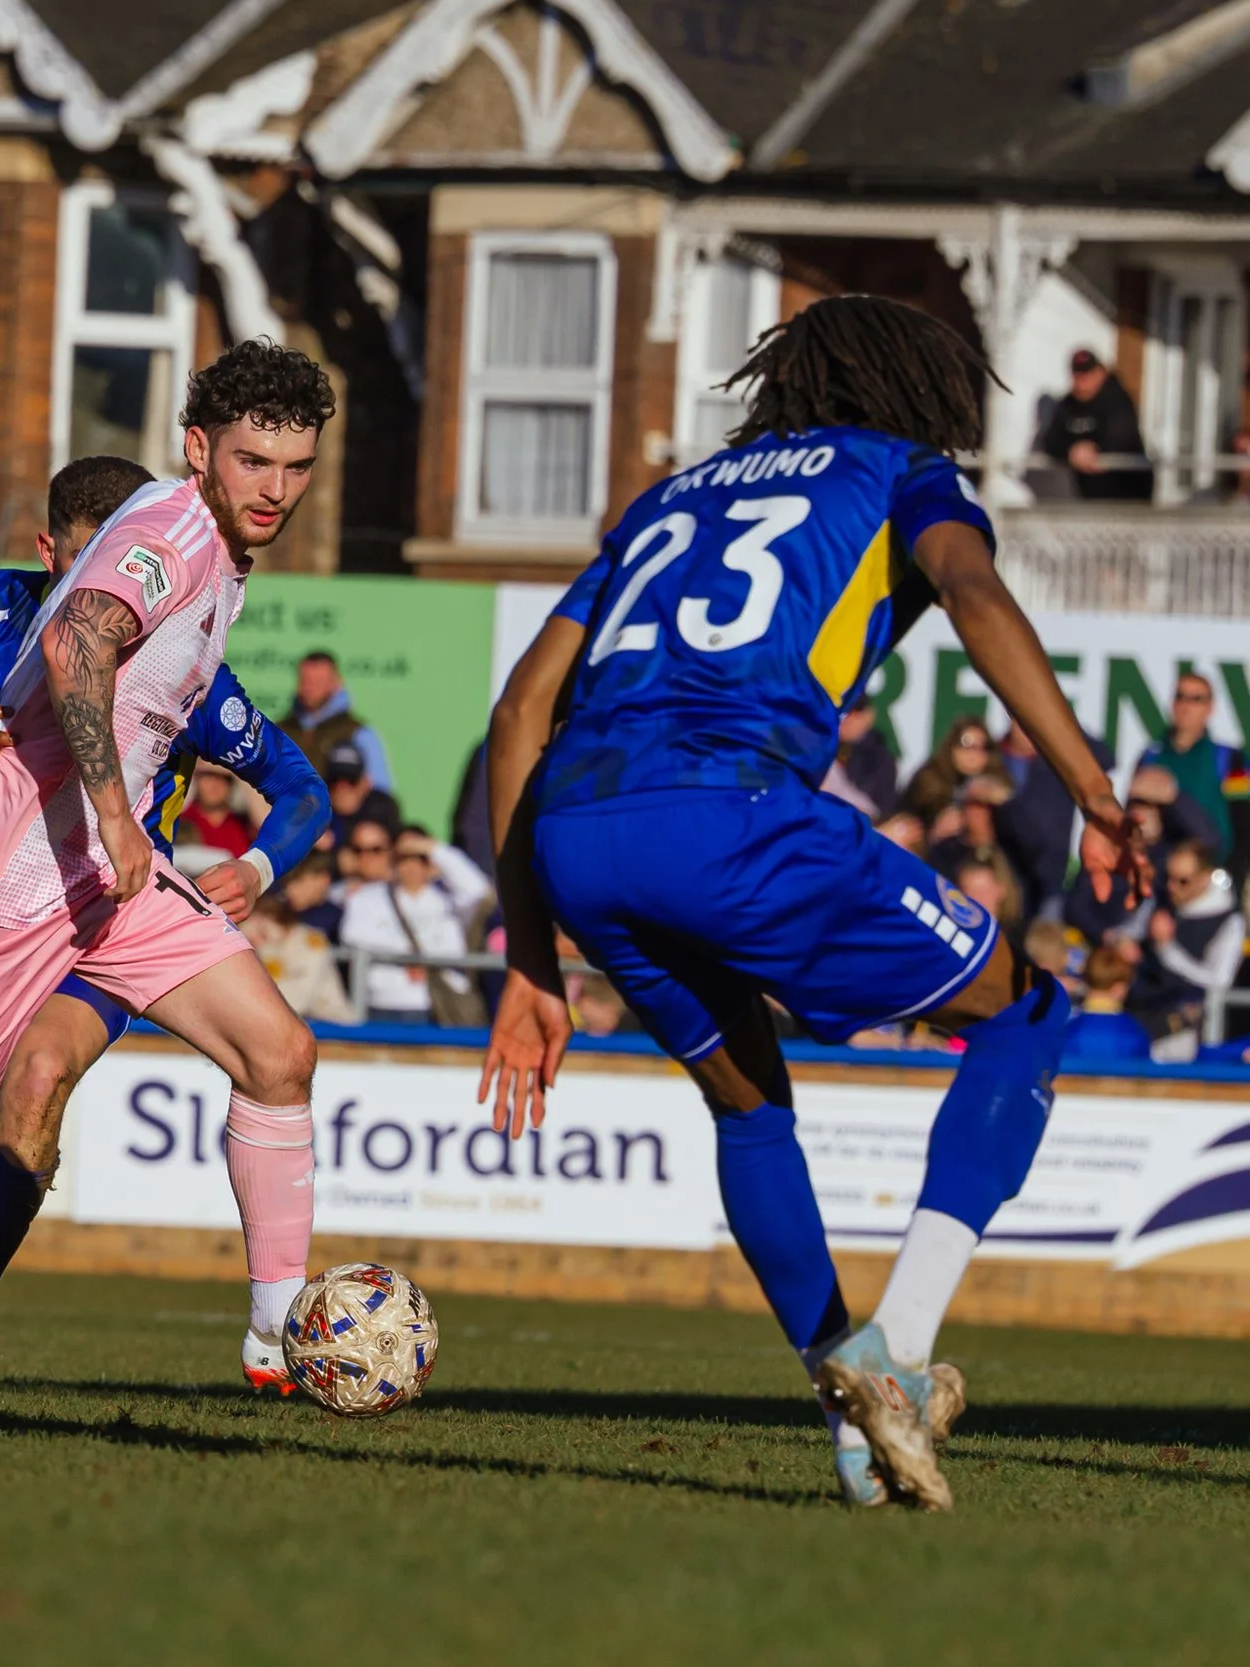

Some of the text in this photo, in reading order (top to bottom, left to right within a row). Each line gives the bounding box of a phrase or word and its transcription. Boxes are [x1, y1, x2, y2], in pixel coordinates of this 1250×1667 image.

[587, 495, 812, 667] 23
[154, 868, 211, 917] 1
[128, 1079, 669, 1182] Slfordian
